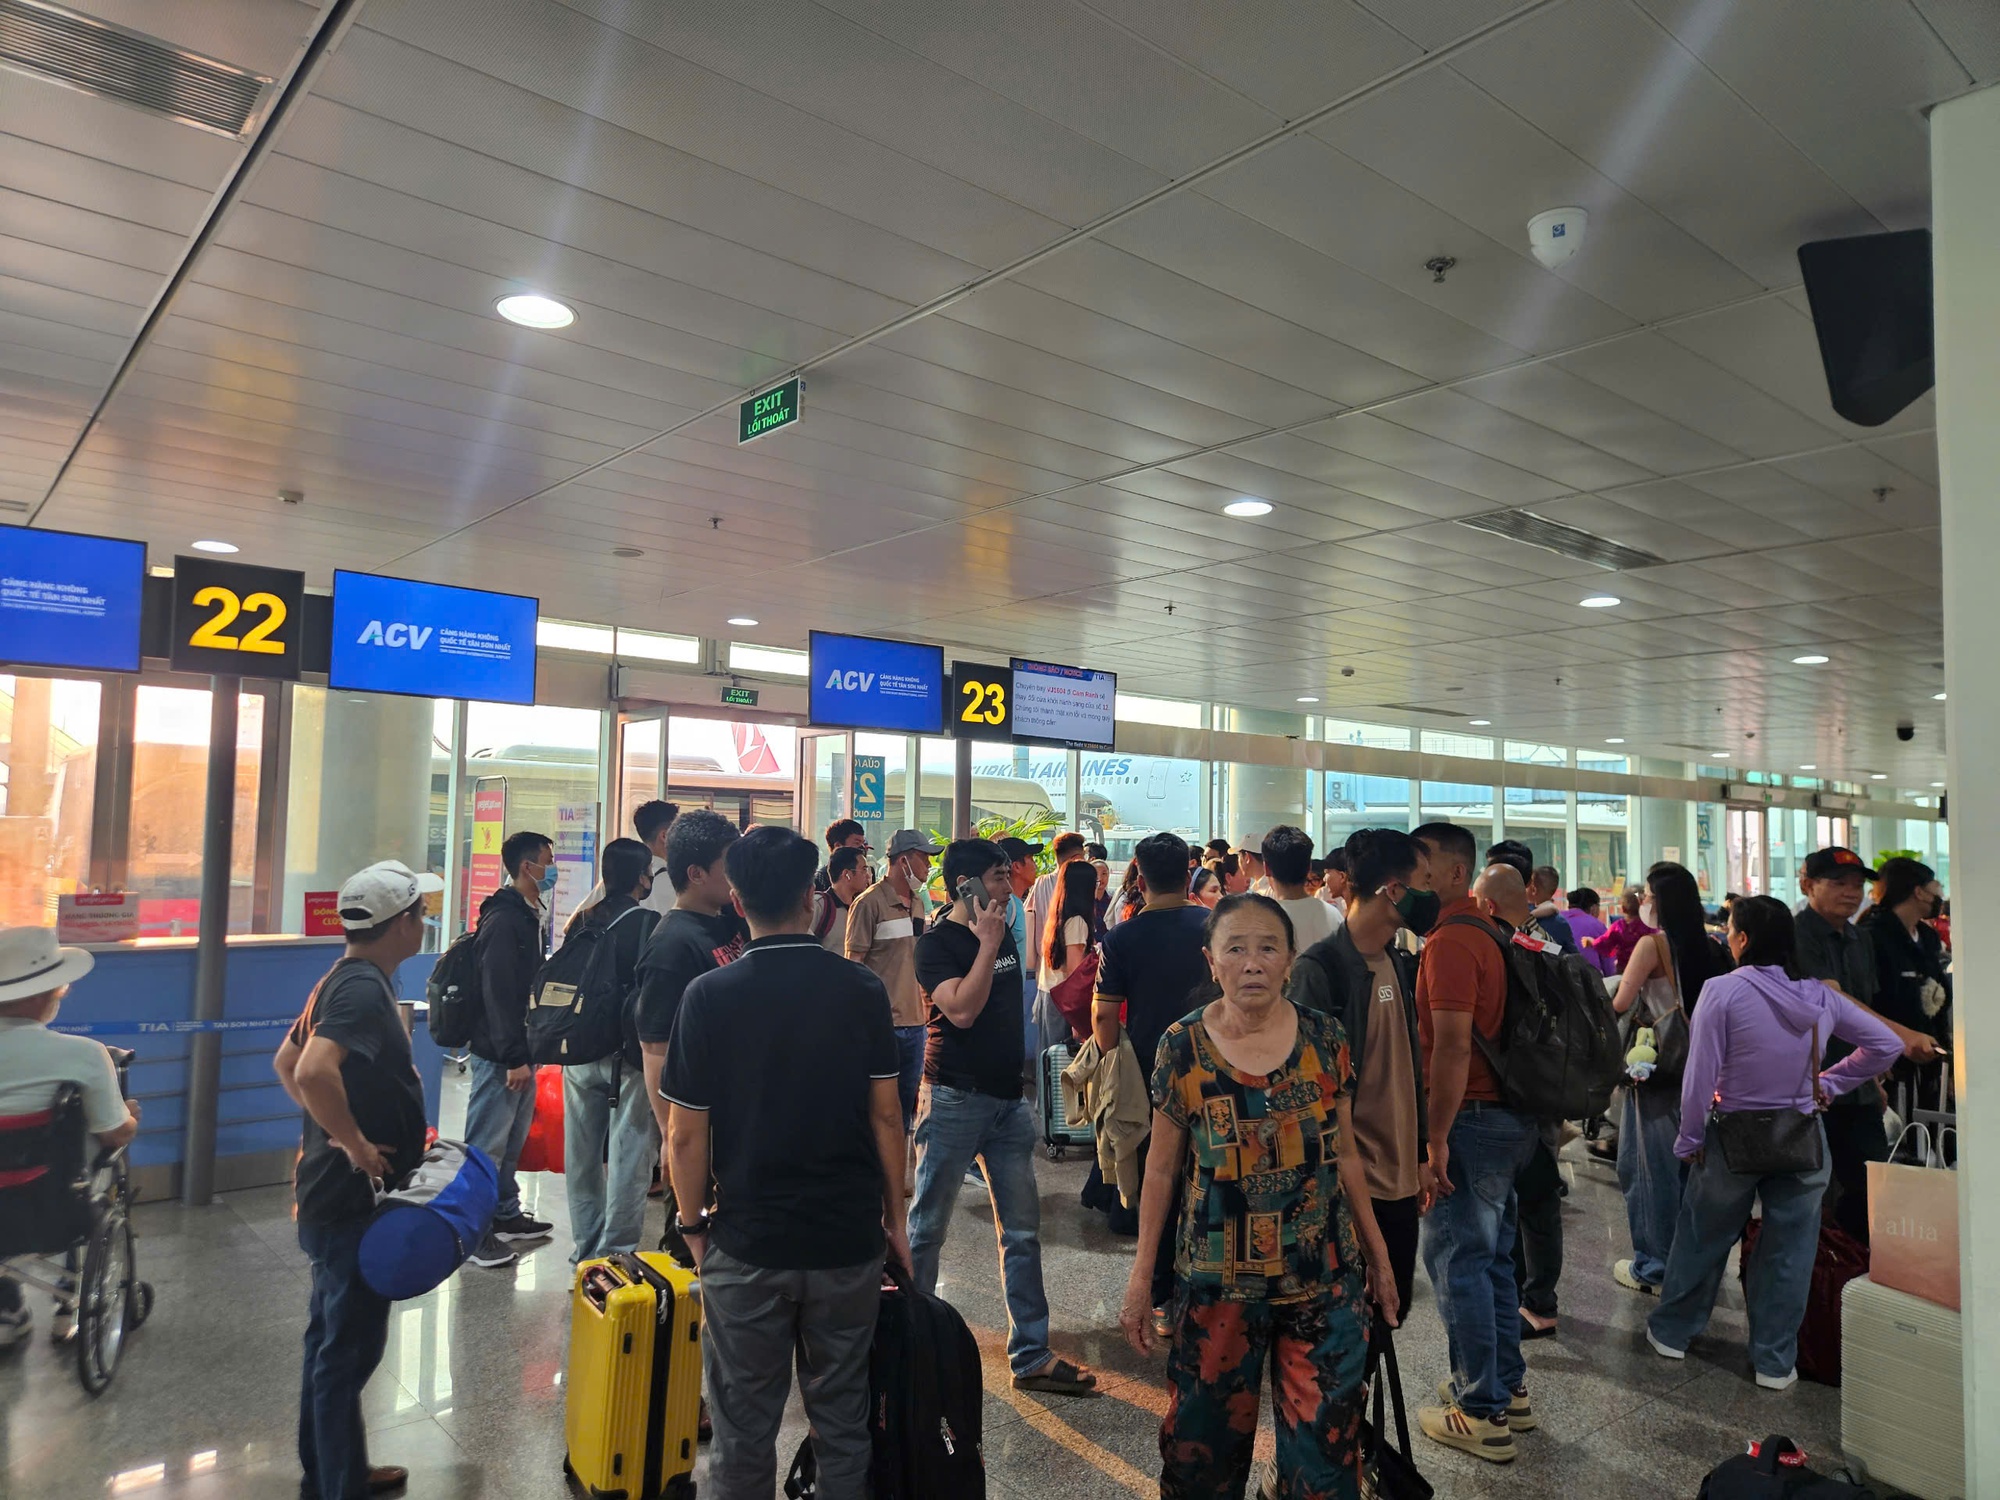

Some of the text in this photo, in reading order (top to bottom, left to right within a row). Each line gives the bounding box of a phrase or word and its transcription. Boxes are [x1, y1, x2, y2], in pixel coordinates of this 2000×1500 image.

[754, 389, 784, 416] EXIT
[747, 406, 790, 435] LỐI THOÁT
[188, 586, 287, 654] 22
[357, 620, 433, 650] ACV
[440, 627, 499, 641] CẢNG HÀNG KHÔNG
[440, 636, 458, 644] QUỐC
[459, 637, 467, 645] TẾ
[480, 641, 494, 649] SƠN
[494, 642, 511, 650] NHẤT
[825, 669, 875, 692] ACV
[1095, 673, 1105, 681] TIA
[730, 689, 750, 697] EXIT
[961, 681, 1006, 725] 23
[1038, 758, 1132, 779] AIRINES
[560, 807, 574, 821] TIA
[138, 1022, 170, 1032] TIA
[249, 1020, 271, 1028] NHAT
[1873, 1212, 1939, 1242] Callia
